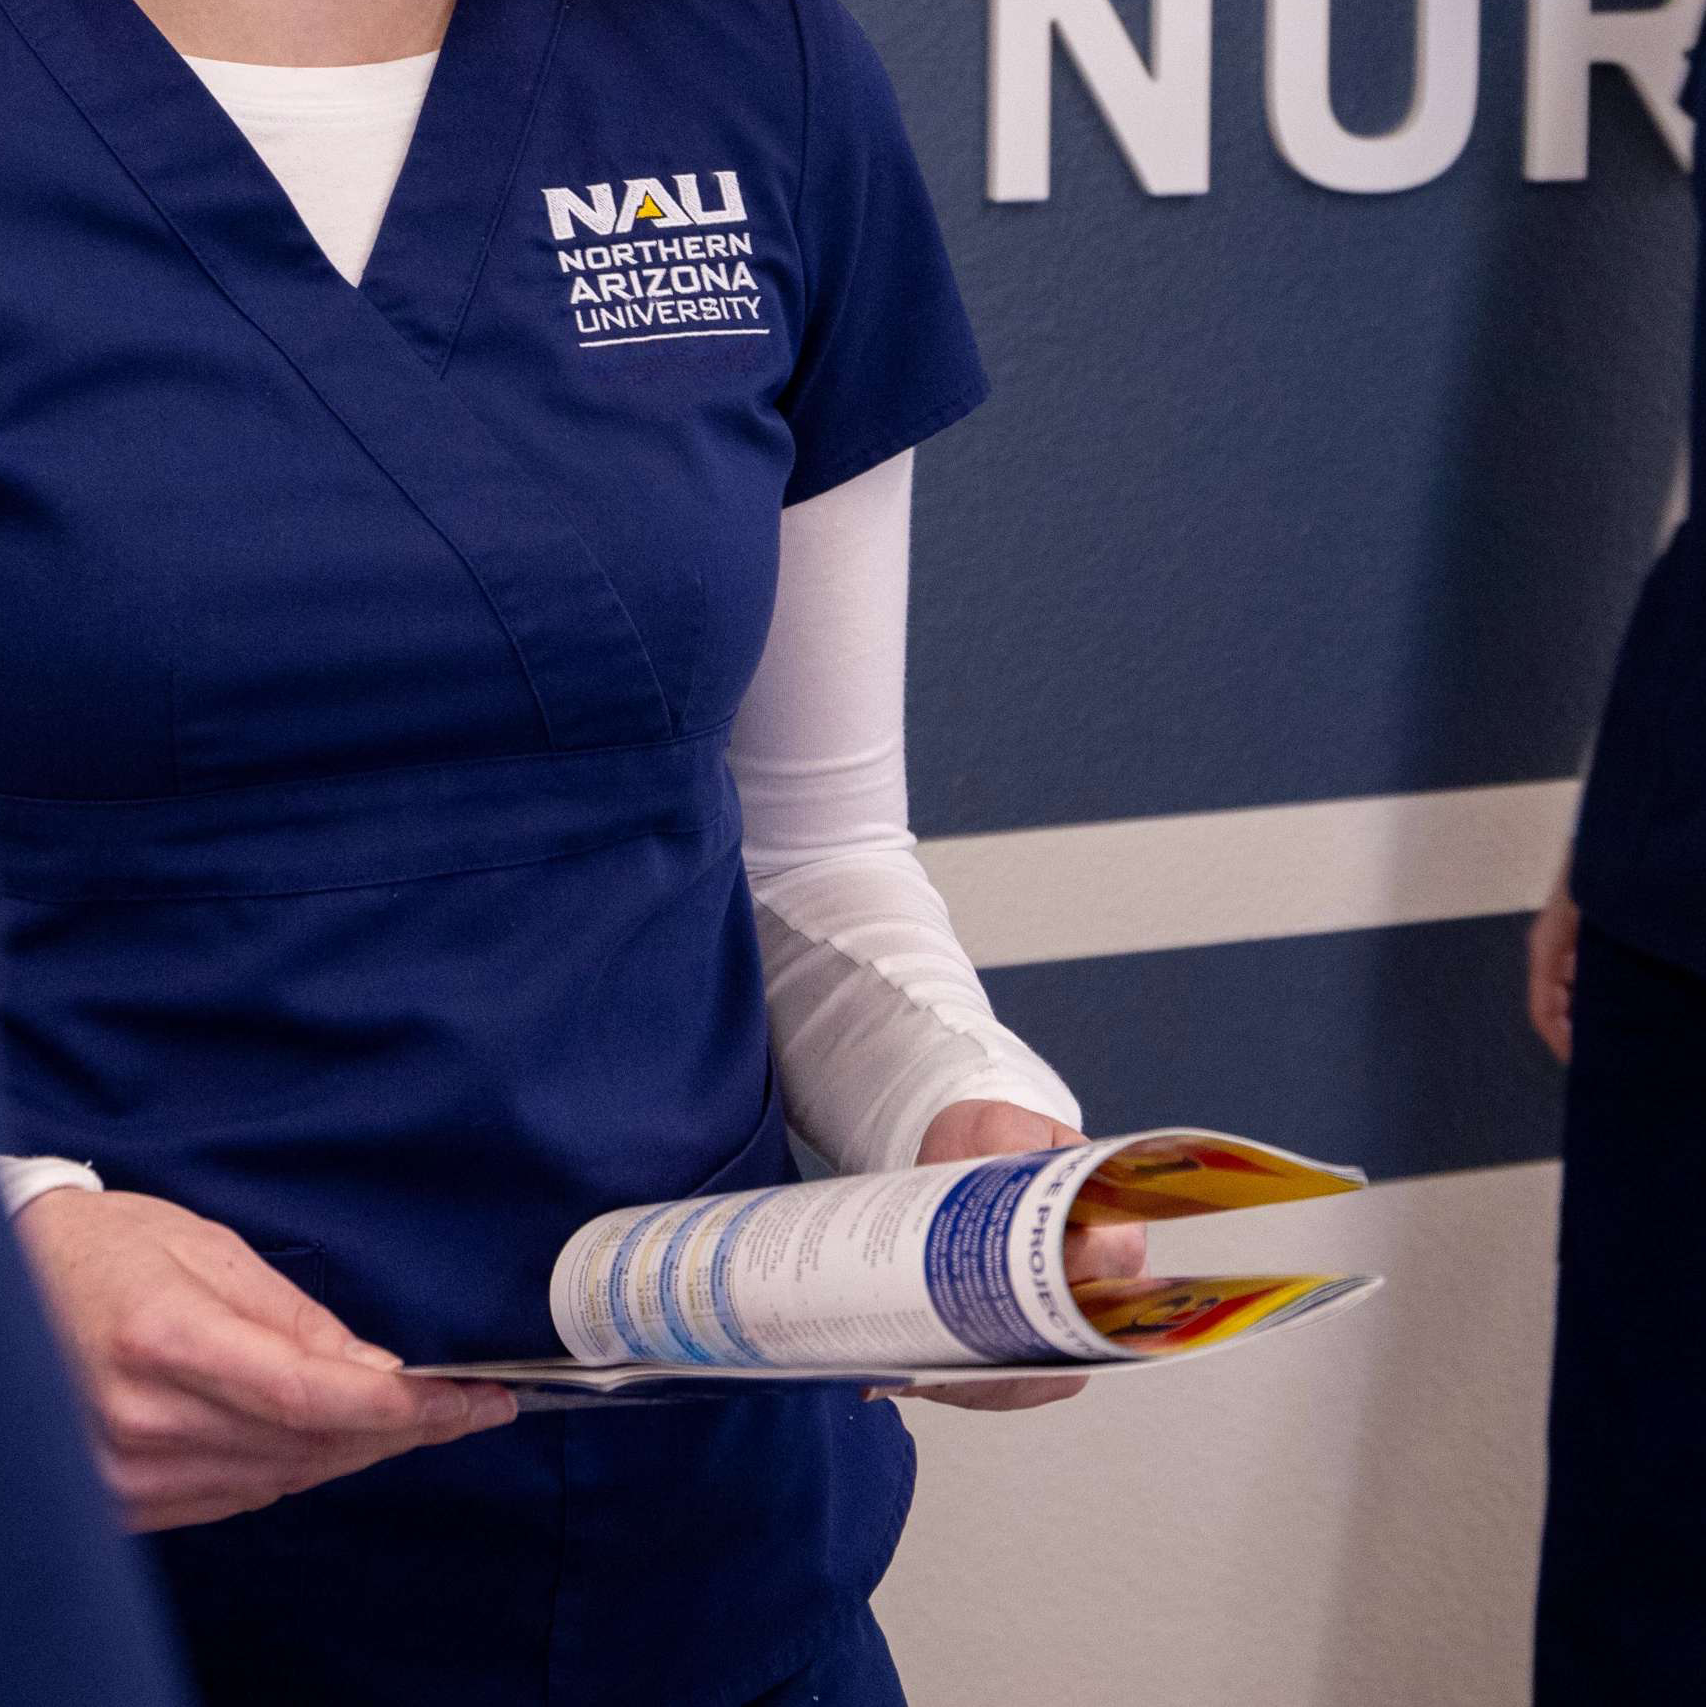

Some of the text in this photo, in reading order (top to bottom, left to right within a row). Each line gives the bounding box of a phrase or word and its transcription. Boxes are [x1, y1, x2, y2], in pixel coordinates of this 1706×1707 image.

[541, 171, 748, 241] NAU
[557, 232, 753, 273] NORTHERN
[570, 260, 759, 305] ARIZONA
[575, 295, 762, 333] UNIVERSITY
